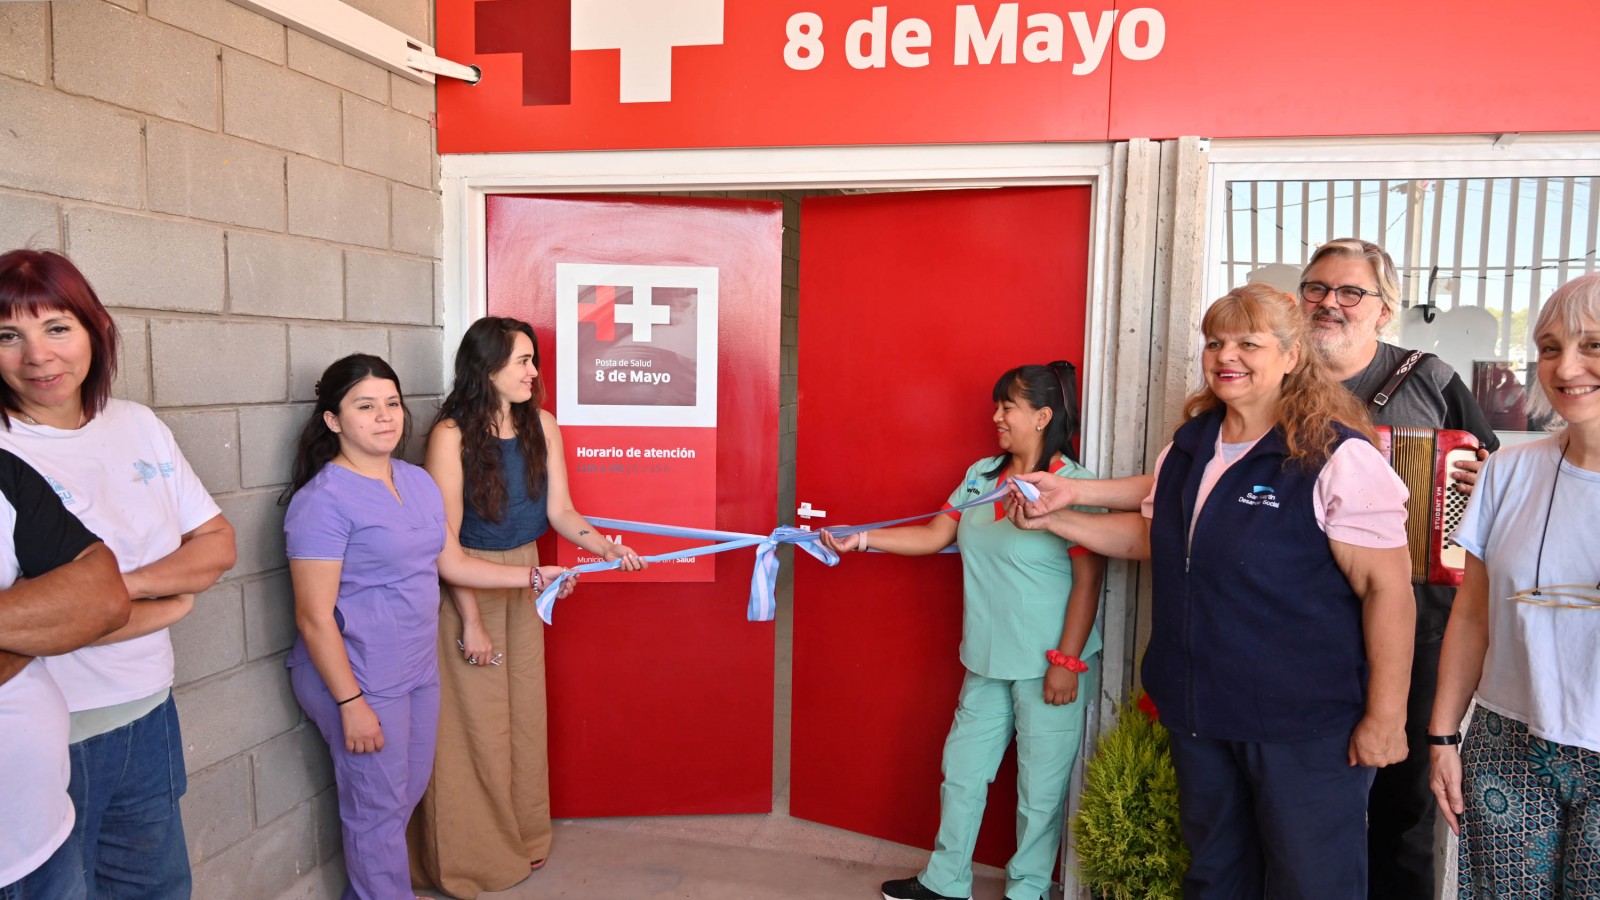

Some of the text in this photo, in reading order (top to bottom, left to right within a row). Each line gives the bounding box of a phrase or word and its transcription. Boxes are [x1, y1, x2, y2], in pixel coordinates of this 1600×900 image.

[783, 3, 1167, 76] 8 de Mayo
[595, 358, 652, 368] Posta de Salud
[595, 370, 671, 385] 8 de Mayo
[576, 447, 696, 458] Horario de atención
